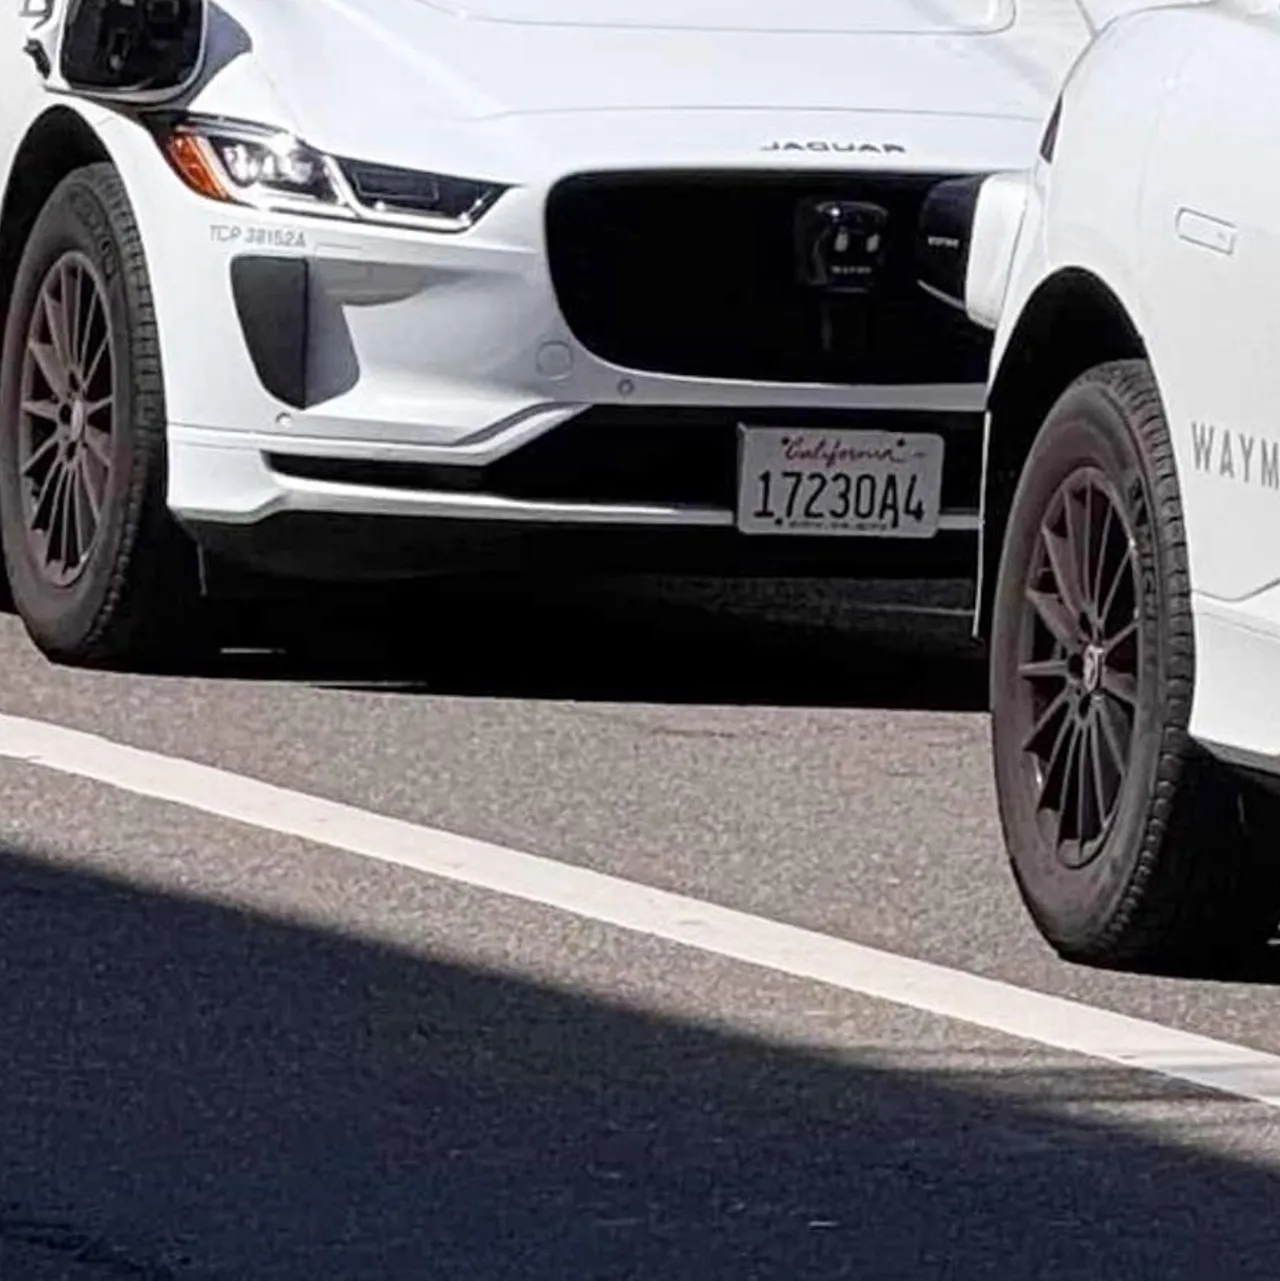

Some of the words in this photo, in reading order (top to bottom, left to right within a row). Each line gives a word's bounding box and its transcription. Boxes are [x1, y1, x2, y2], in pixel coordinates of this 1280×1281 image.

[761, 141, 906, 153] JAGUAR
[784, 436, 910, 468] California
[753, 470, 925, 528] 17230A4
